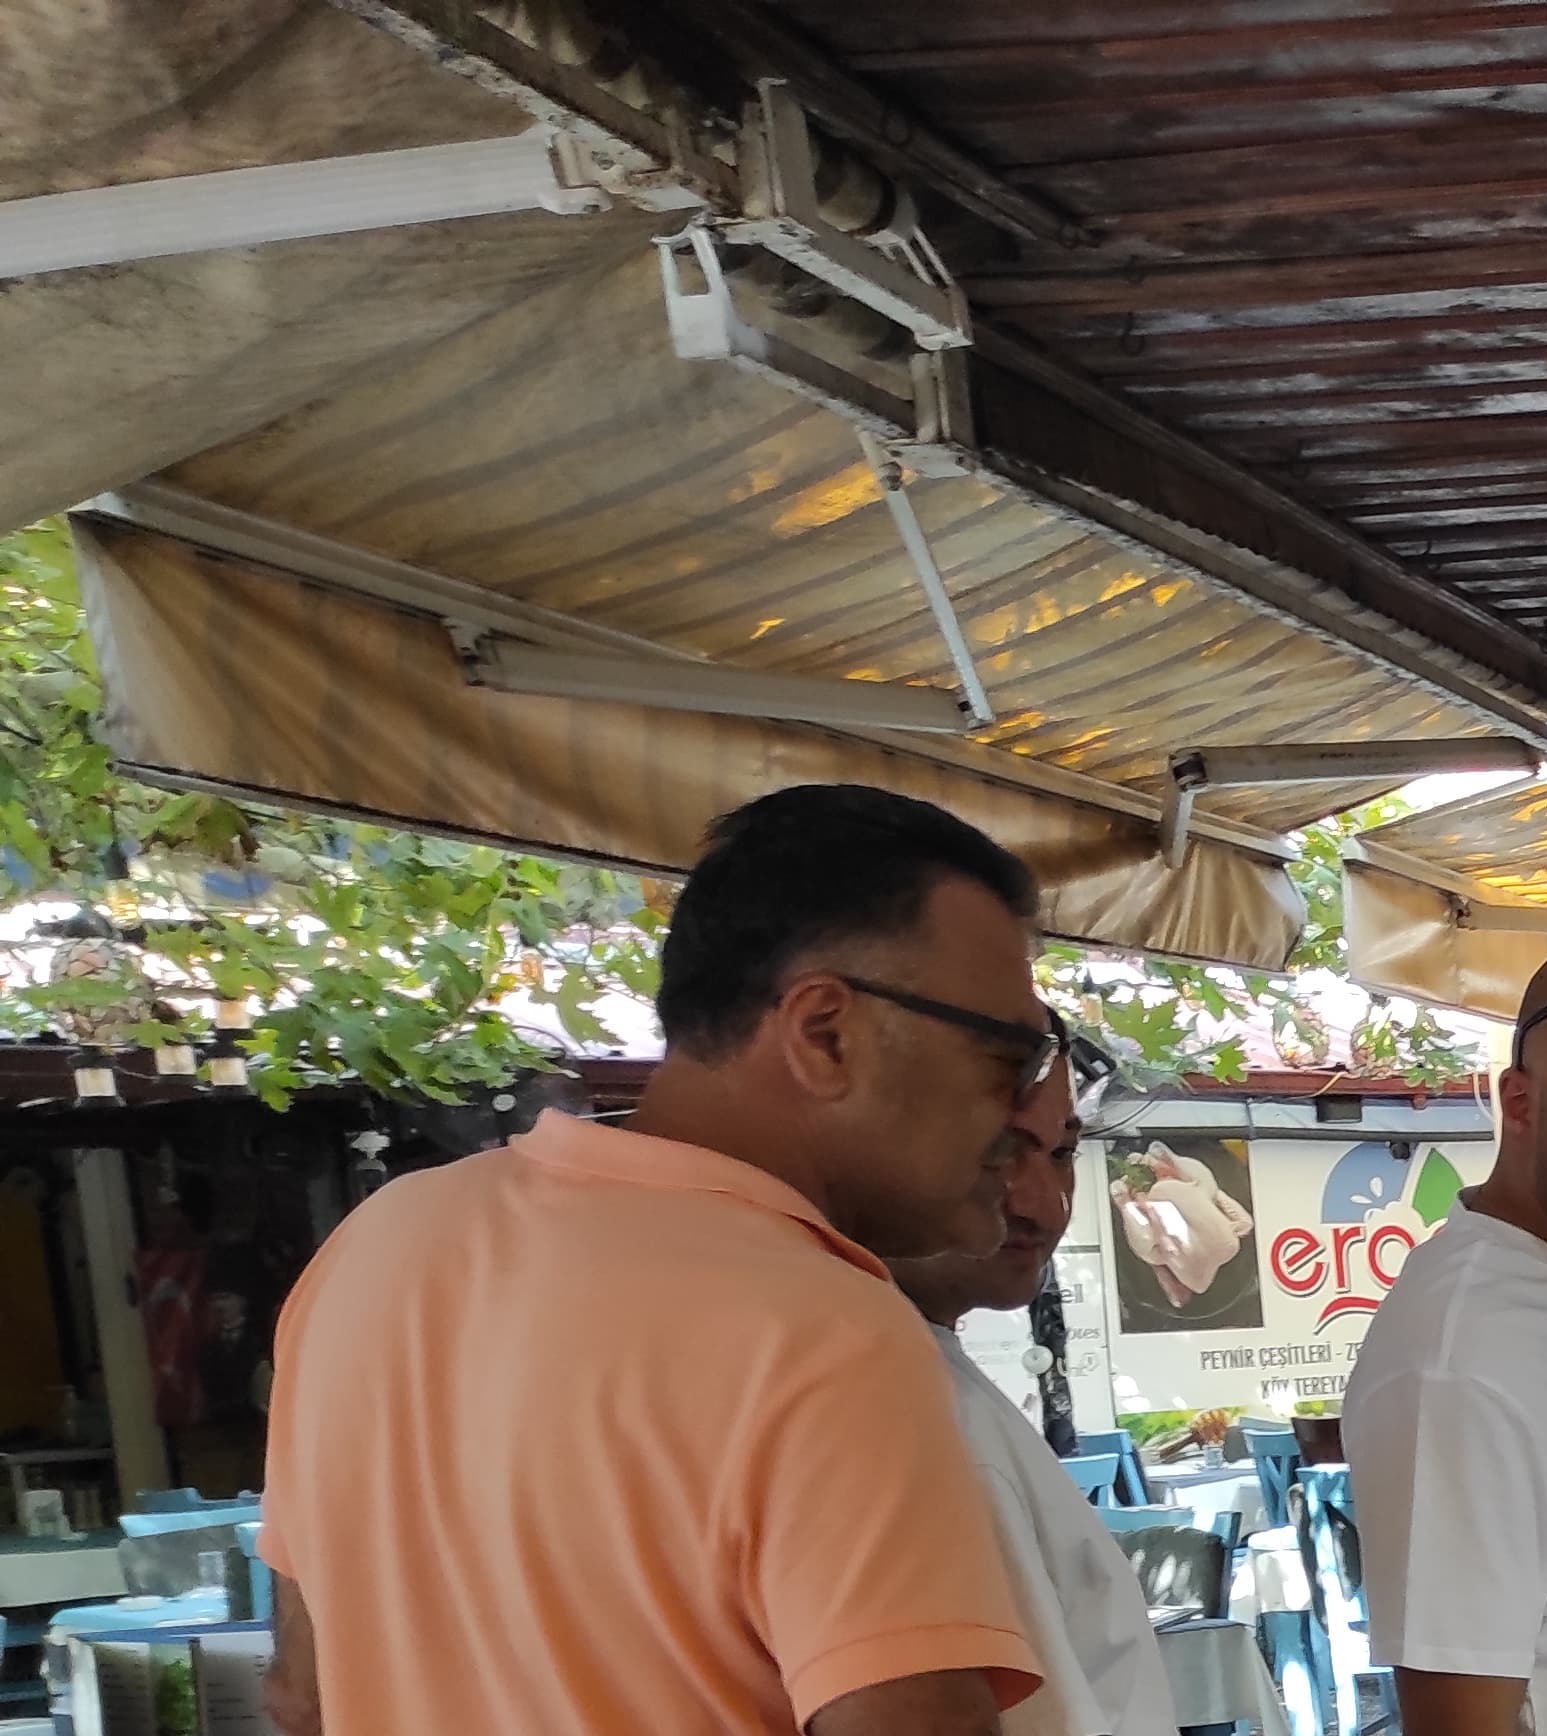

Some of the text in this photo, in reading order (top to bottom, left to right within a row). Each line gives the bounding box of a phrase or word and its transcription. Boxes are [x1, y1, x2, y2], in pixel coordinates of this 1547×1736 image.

[1271, 1225, 1446, 1293] ero
[1201, 1346, 1255, 1370] PEYNİR
[1259, 1341, 1331, 1369] ÇEŞİTLERİ
